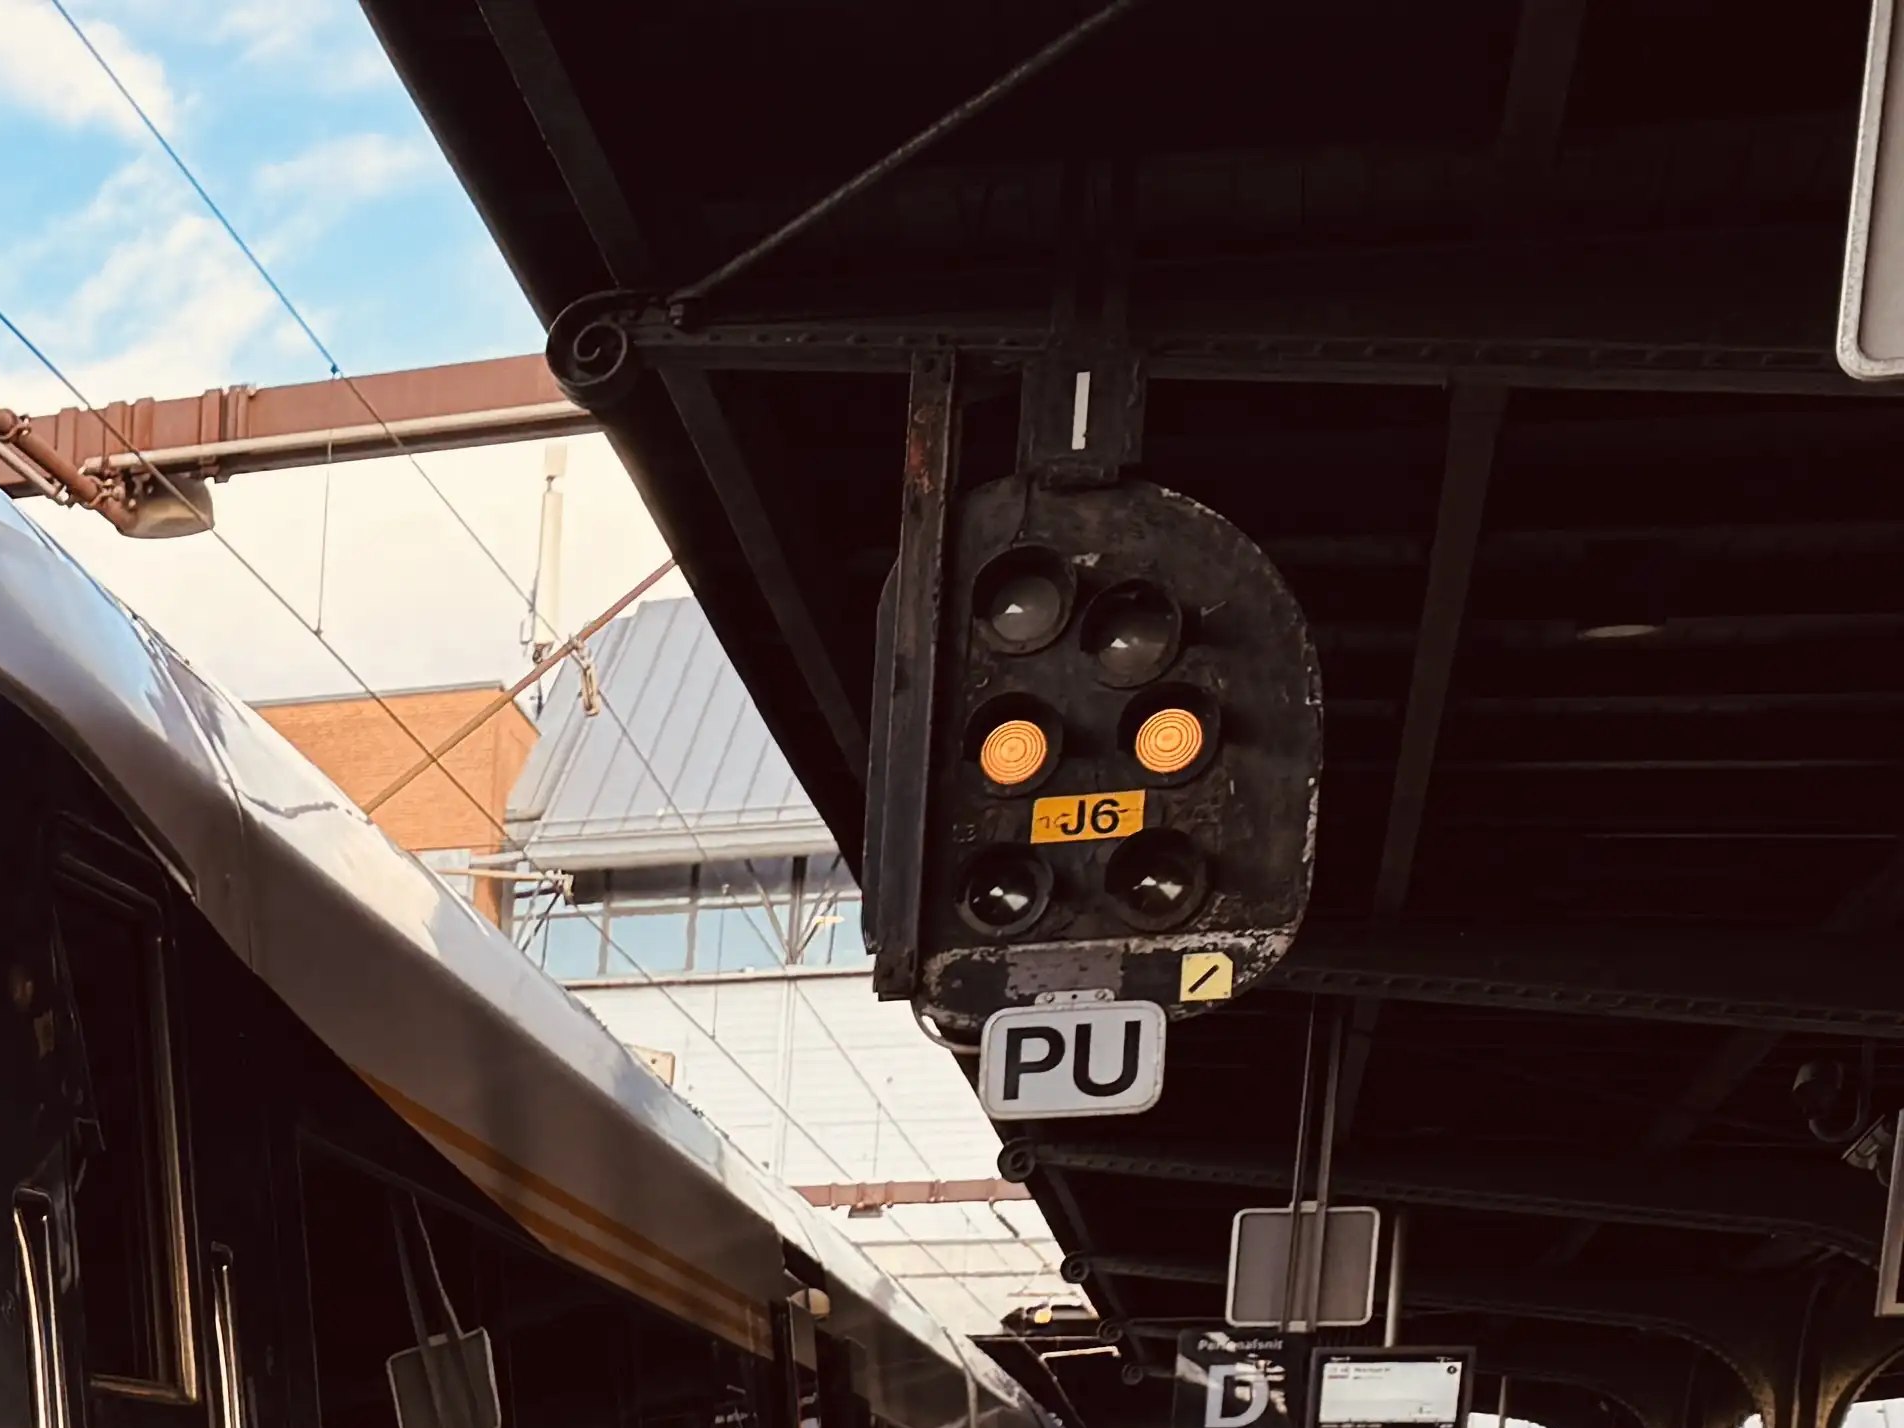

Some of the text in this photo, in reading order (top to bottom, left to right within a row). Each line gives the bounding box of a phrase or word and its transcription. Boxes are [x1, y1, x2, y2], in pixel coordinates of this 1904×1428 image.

[1061, 799, 1120, 836] J6
[1003, 1020, 1141, 1100] PU
[1204, 1364, 1270, 1428] D
